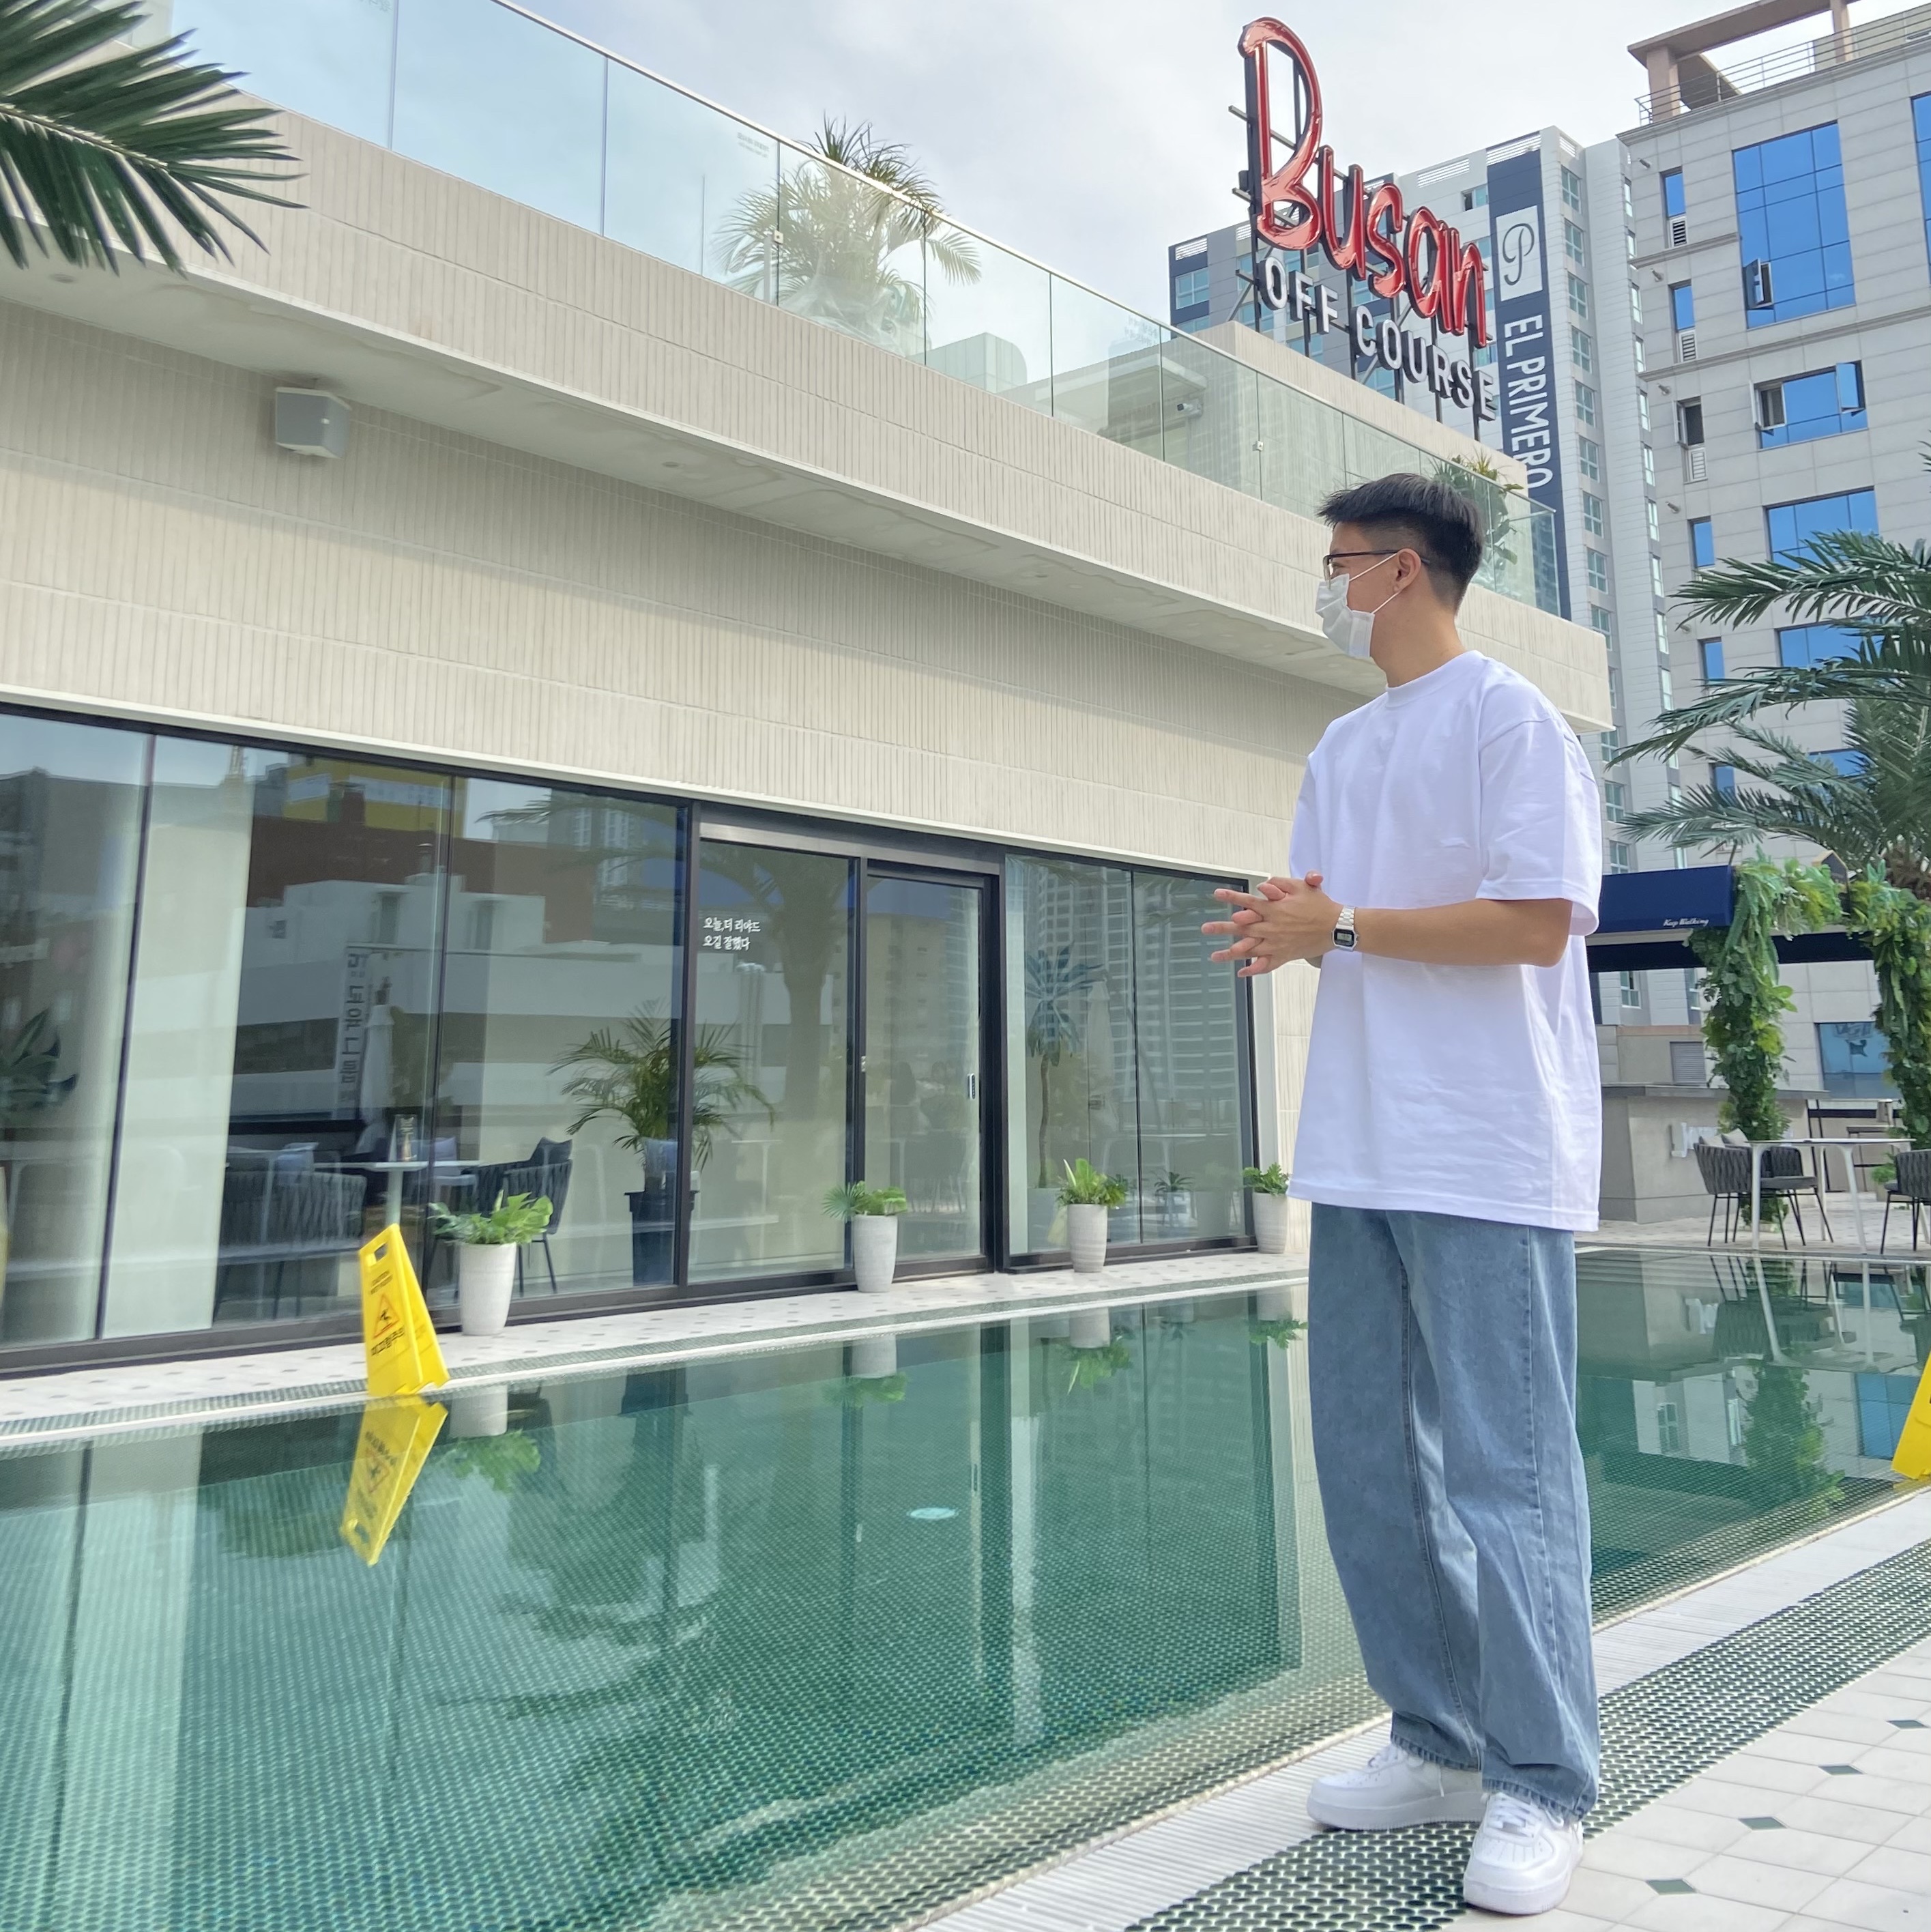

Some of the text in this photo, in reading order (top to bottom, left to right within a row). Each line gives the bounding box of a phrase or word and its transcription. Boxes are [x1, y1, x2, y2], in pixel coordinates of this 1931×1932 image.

[1238, 16, 1486, 348] Busan
[1260, 255, 1496, 422] OFF COURSE
[1504, 314, 1554, 489] EL PRIMERO
[703, 935, 751, 951] 오길 잘했다
[734, 918, 761, 934] 리야드
